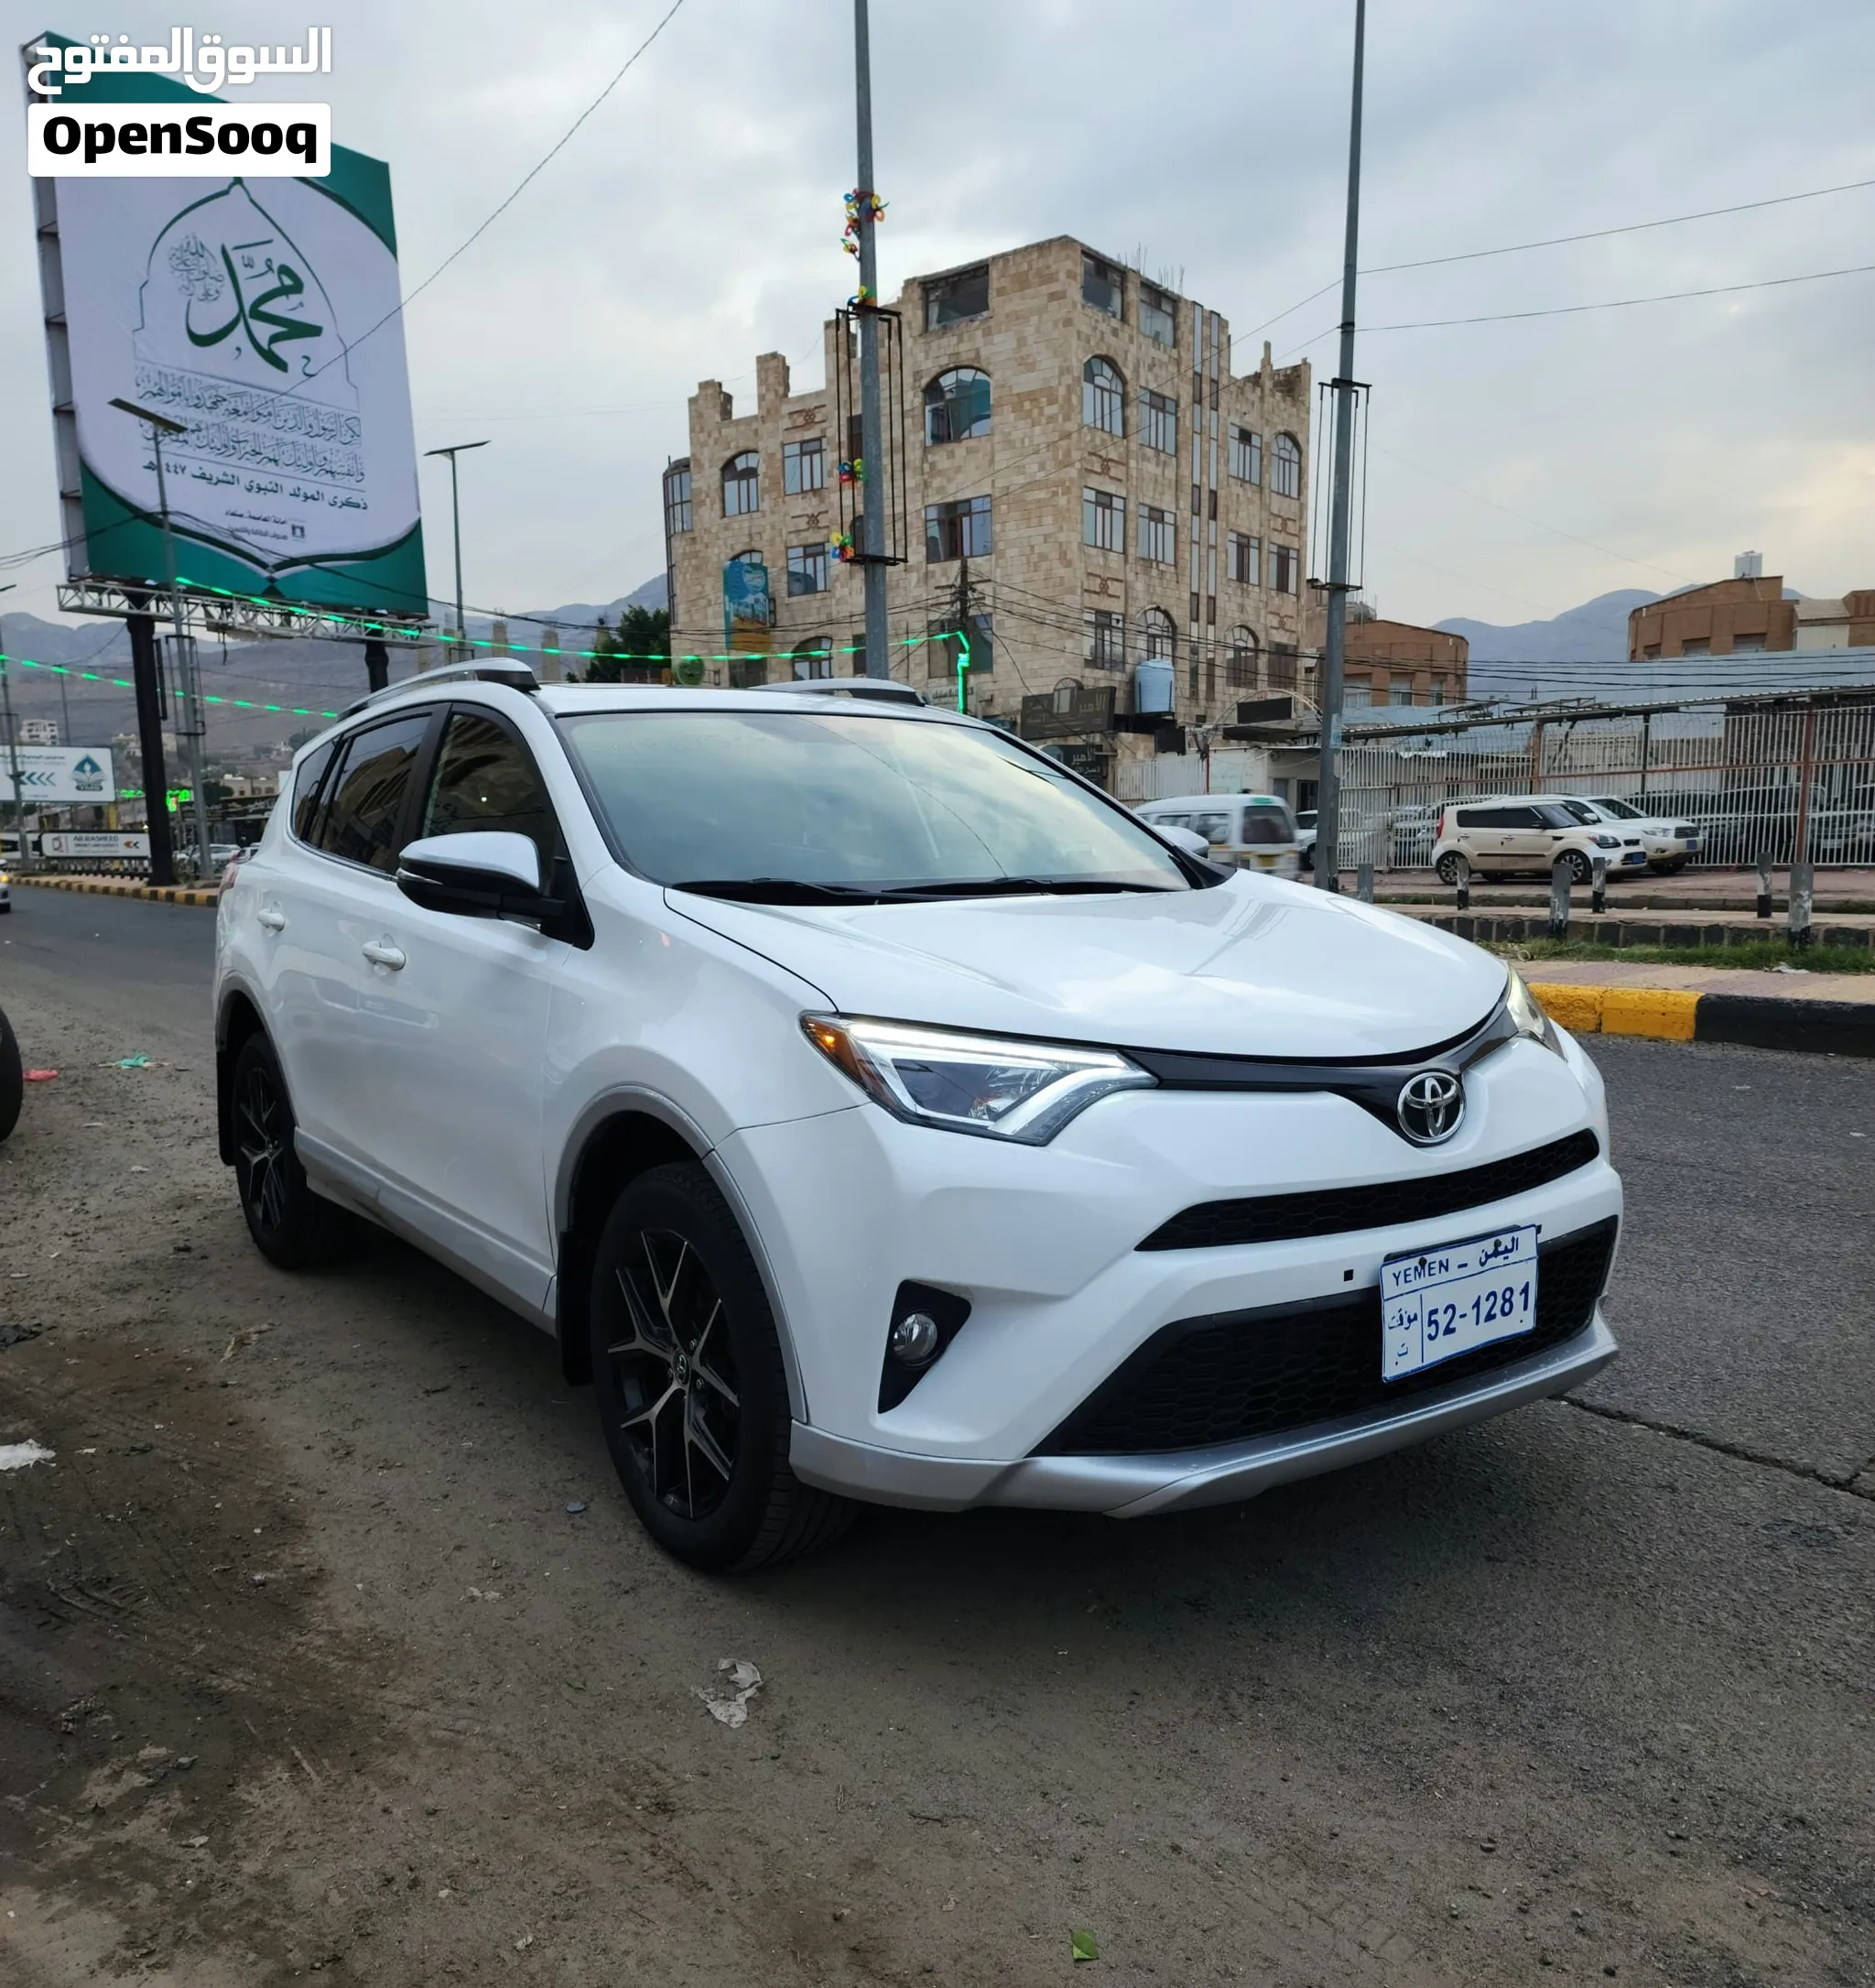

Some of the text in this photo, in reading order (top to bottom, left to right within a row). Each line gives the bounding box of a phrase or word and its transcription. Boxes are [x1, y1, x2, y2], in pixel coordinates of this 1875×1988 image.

[190, 465, 240, 486] الشريف
[289, 485, 325, 503] المولد
[328, 496, 368, 510] ذكرى
[1393, 1258, 1450, 1287] YEMEN
[1479, 1236, 1520, 1267] اليمن
[1427, 1281, 1530, 1342] 52-1281
